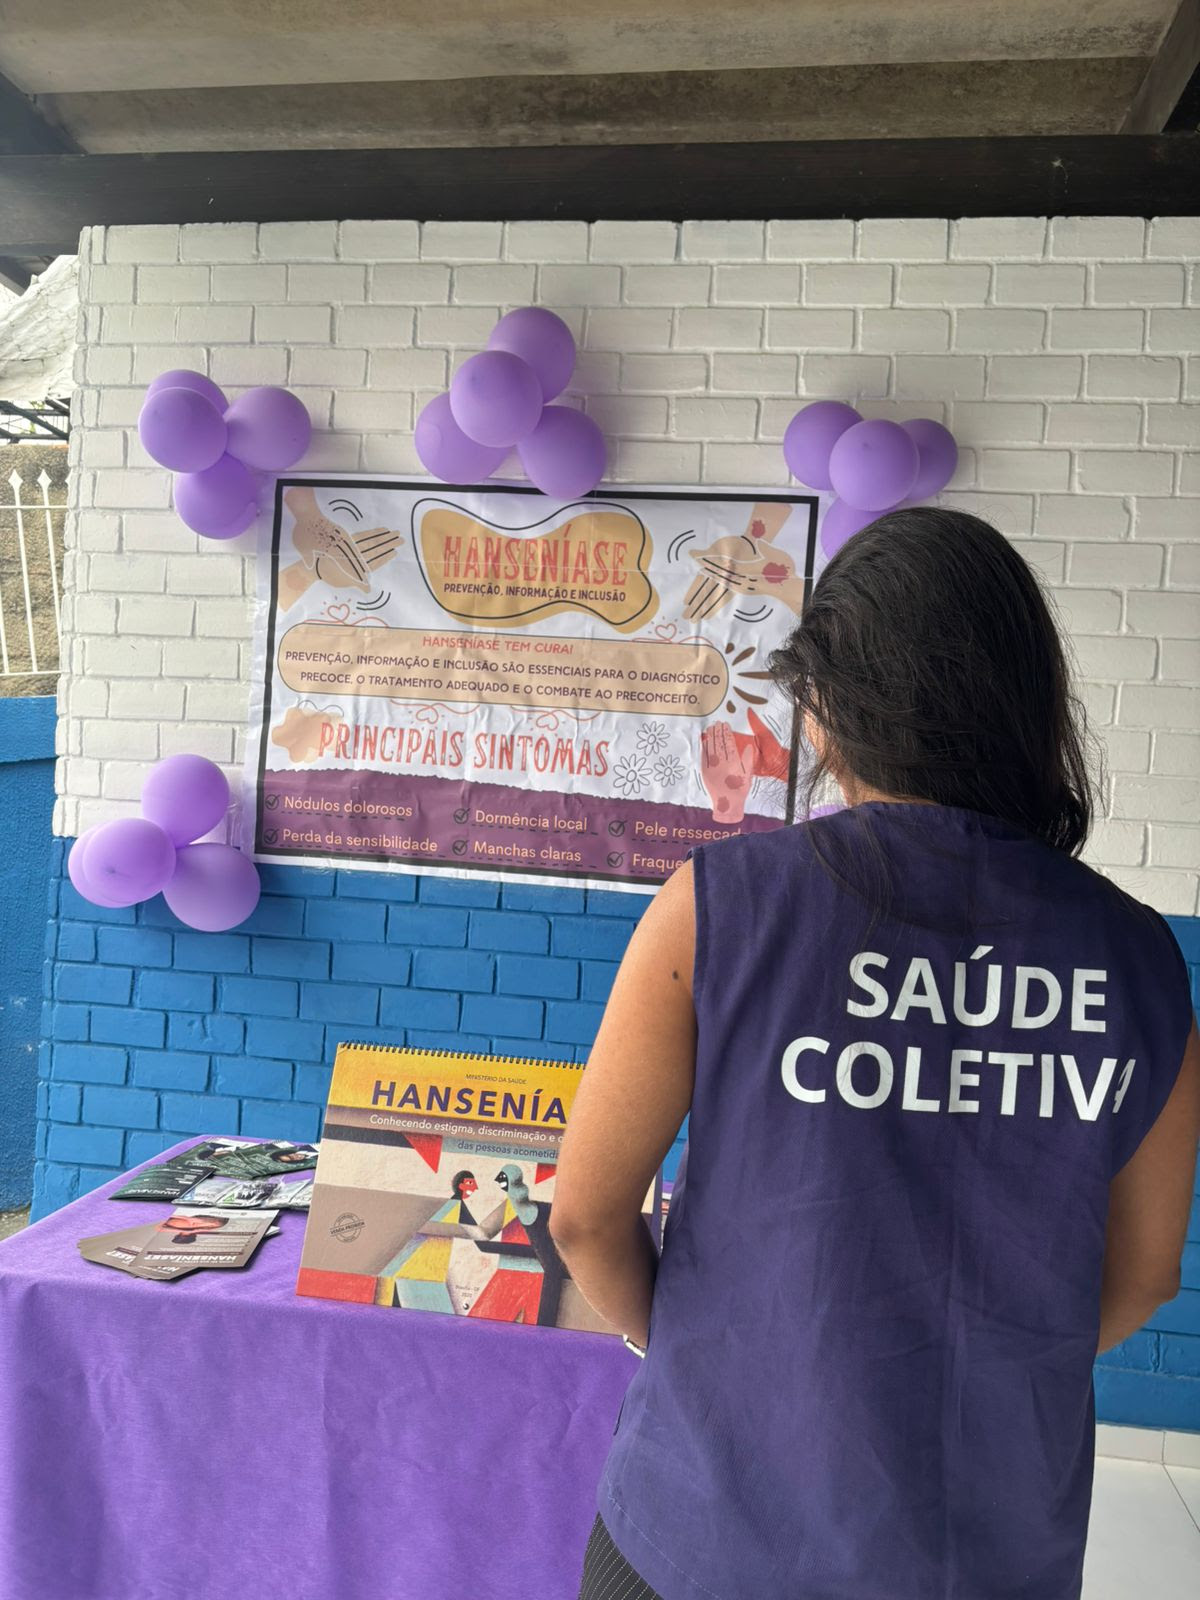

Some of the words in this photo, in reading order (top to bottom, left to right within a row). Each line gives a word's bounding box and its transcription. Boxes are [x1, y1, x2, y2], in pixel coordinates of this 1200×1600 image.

[443, 524, 628, 586] HANSENÍASE
[506, 585, 567, 600] INFORMAÇÃO
[570, 590, 576, 598] E
[578, 589, 626, 602] INCLUSÃO
[423, 636, 500, 650] HANSENÍASE
[505, 640, 530, 652] TEM
[534, 642, 573, 655] CURA!
[357, 655, 430, 669] INFORMAÇÃO
[432, 658, 440, 668] E
[443, 659, 498, 672] INCLUSÃO
[502, 661, 525, 673] SÃO
[528, 664, 591, 677] ESSENCIAIS
[594, 668, 624, 679] PARA
[627, 670, 637, 680] O
[641, 670, 721, 685] DIAGNÓSTICO
[356, 675, 365, 684] O
[368, 676, 443, 689] TRATAMENTO
[446, 680, 509, 693] ADEQUADO
[513, 684, 520, 694] E
[523, 685, 532, 695] O
[536, 685, 592, 698] COMBATE
[595, 689, 613, 700] AO
[616, 690, 700, 706] PRECONCEITO.
[318, 722, 465, 768] PRINCIPAIS
[474, 731, 610, 777] SINTOMAS
[284, 796, 340, 812] Nódulos
[344, 800, 413, 817] dolorosos
[475, 810, 550, 829] Dormência
[554, 813, 588, 831] local
[635, 821, 668, 837] Pele
[672, 827, 742, 841] ressecad
[283, 829, 322, 843] Perda
[325, 832, 342, 845] da
[346, 834, 438, 852] sensibilidade
[474, 841, 535, 858] Manchas
[540, 846, 582, 862] claras
[633, 853, 683, 872] Fraque
[846, 945, 1107, 1033] SAÚDE
[371, 1080, 567, 1124] HANSENÍA
[370, 1114, 432, 1130] Conhecendo
[434, 1121, 475, 1138] estigma,
[478, 1124, 546, 1143] discriminação
[549, 1133, 556, 1142] e
[457, 1139, 473, 1150] das
[475, 1143, 511, 1156] pessoas
[513, 1146, 558, 1160] acometid
